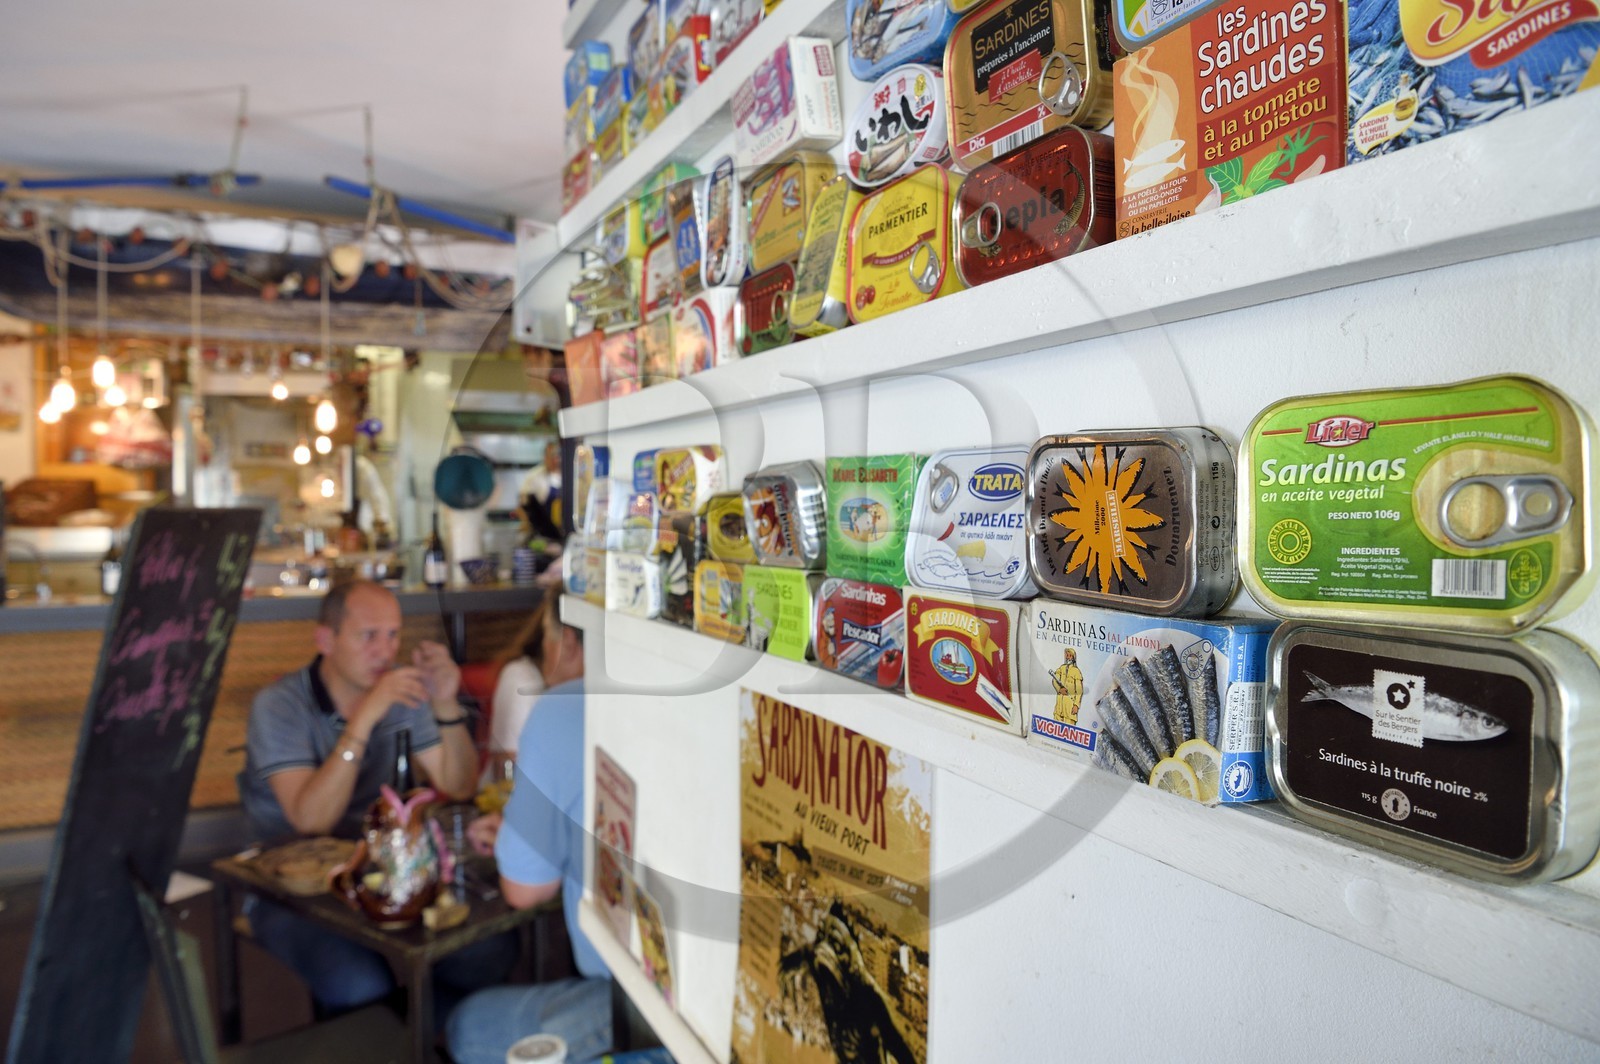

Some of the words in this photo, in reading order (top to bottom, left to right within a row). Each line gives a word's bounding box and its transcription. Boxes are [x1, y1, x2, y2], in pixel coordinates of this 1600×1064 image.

[975, 0, 1050, 59] SARDINES
[1217, 6, 1246, 37] les
[1487, 2, 1571, 58] SARDINES
[1198, 0, 1327, 78] Sardines
[977, 51, 1008, 78] préparées
[1009, 47, 1014, 57] à
[1014, 26, 1051, 53] l'ancienne
[1201, 33, 1324, 114] chaudes
[1204, 126, 1215, 143] à
[1221, 119, 1238, 138] la
[1243, 77, 1321, 125] tomate
[1359, 115, 1389, 129] SARDINES
[1204, 142, 1224, 161] et
[1230, 128, 1253, 147] au
[1260, 95, 1327, 142] pistou
[969, 136, 986, 151] Dia
[1138, 185, 1183, 206] MICRO-ONDES
[1159, 183, 1168, 192] AU
[1148, 195, 1180, 210] PAPILLOTE
[868, 202, 928, 239] PARMENTIER
[1131, 226, 1139, 236] la
[1305, 420, 1375, 443] Líder
[1412, 438, 1441, 454] LEVANTE
[1451, 431, 1477, 440] ANILLO
[974, 473, 1023, 491] TRATA
[1211, 461, 1219, 480] 115g
[1259, 453, 1407, 487] Sardinas
[1261, 492, 1277, 503] en
[1282, 488, 1324, 502] aceite
[1329, 484, 1385, 503] vegetal
[958, 512, 1025, 529] ΣΑΡΔΕΛΕΣ
[1108, 493, 1123, 553] MARSEILLE
[1163, 466, 1181, 567] Douarnenez
[1328, 512, 1349, 520] PESO
[1350, 511, 1373, 519] NETO
[1374, 510, 1400, 521] 106g
[1341, 547, 1400, 555] INGREDIENTES
[840, 583, 886, 606] Sardinhas
[843, 622, 880, 644] Pescador
[927, 611, 981, 636] SARDINES
[1037, 610, 1106, 640] SARDINAS
[1107, 632, 1122, 643] (AL
[1036, 631, 1048, 640] EN
[1051, 634, 1082, 647] ACEITE
[1086, 640, 1129, 656] VEGETAL
[1375, 710, 1387, 718] Sur
[1389, 712, 1395, 720] le
[1396, 714, 1421, 725] Sentier
[1378, 720, 1390, 728] des
[1391, 722, 1418, 734] Bergers
[1036, 718, 1091, 747] VIGILANTE
[1229, 714, 1238, 751] SERPER
[752, 695, 888, 850] SARDINATOR
[1318, 748, 1367, 772] Sardines
[1370, 760, 1377, 774] à
[1380, 763, 1391, 778] la
[1394, 766, 1432, 788] truffe
[1435, 779, 1471, 798] noire
[1361, 792, 1371, 801] 115
[1372, 796, 1378, 804] g
[1413, 806, 1438, 819] France
[794, 802, 806, 819] AU
[810, 809, 839, 838] VIEUX
[840, 827, 871, 856] PORT
